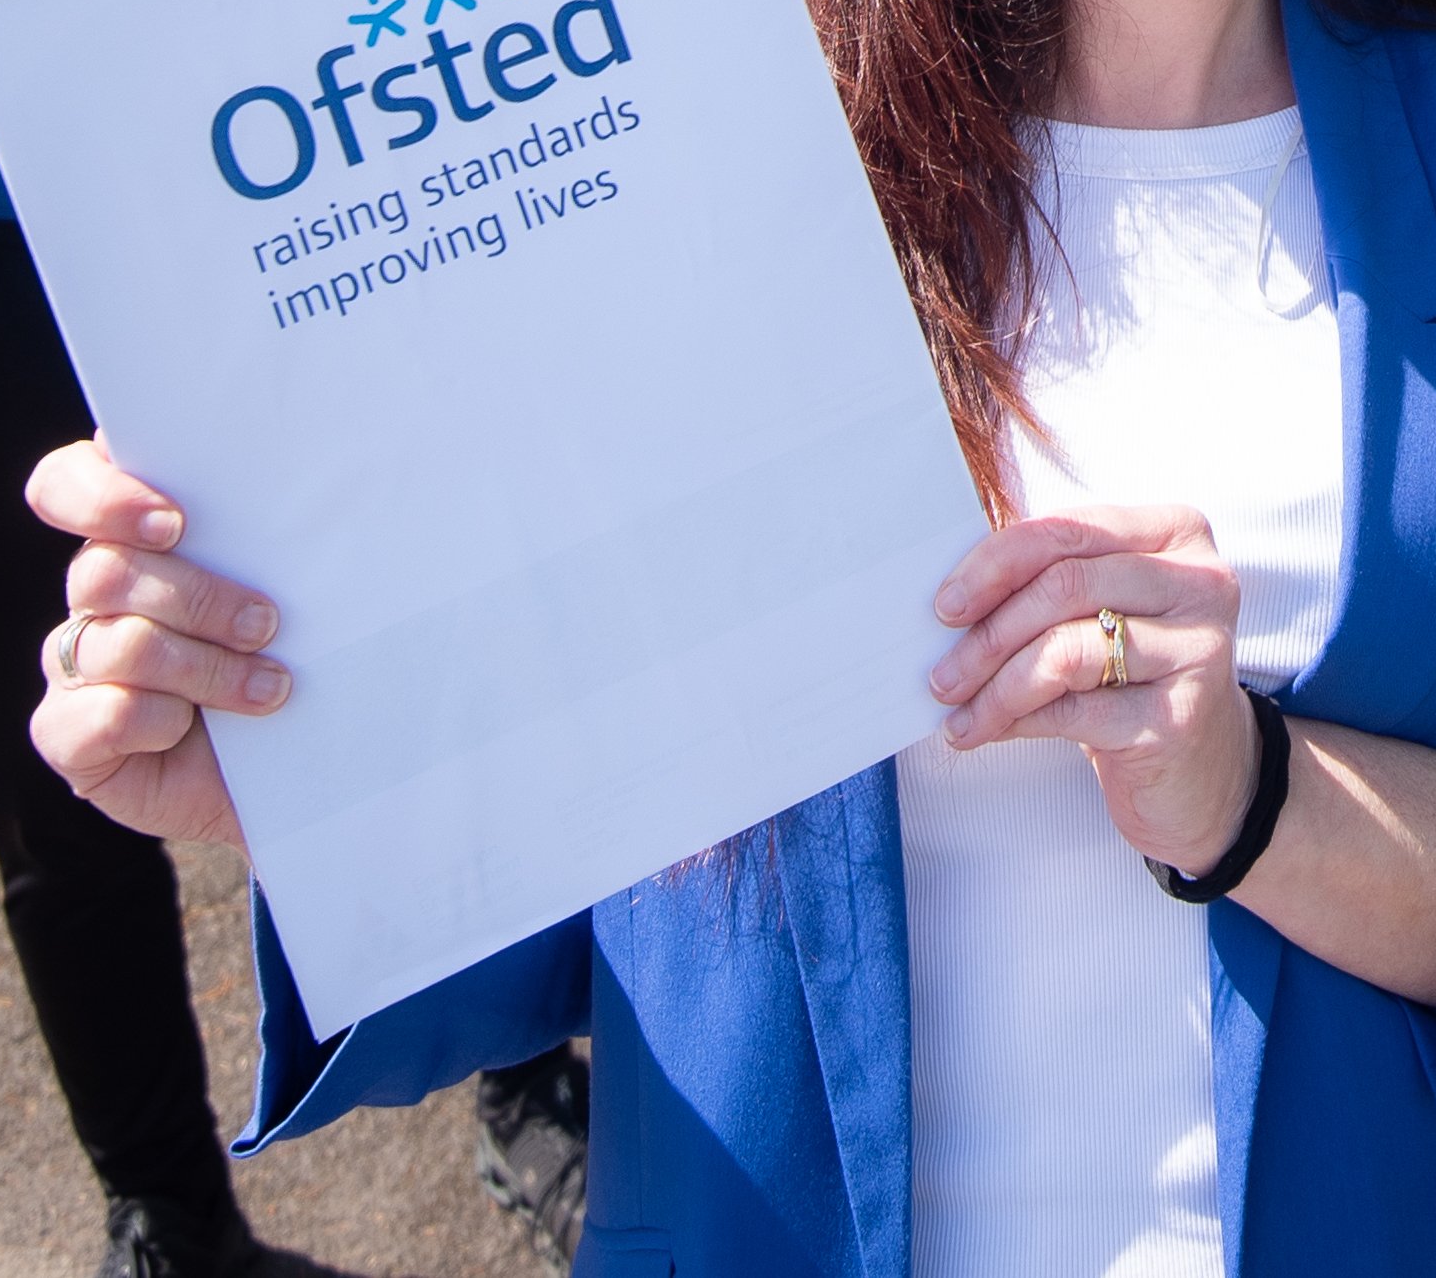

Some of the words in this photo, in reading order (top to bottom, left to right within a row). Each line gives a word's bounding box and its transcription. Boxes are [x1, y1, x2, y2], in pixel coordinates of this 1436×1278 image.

[252, 190, 409, 274] raising
[420, 95, 640, 207] standards
[268, 213, 507, 329] improving
[514, 170, 619, 230] lives
